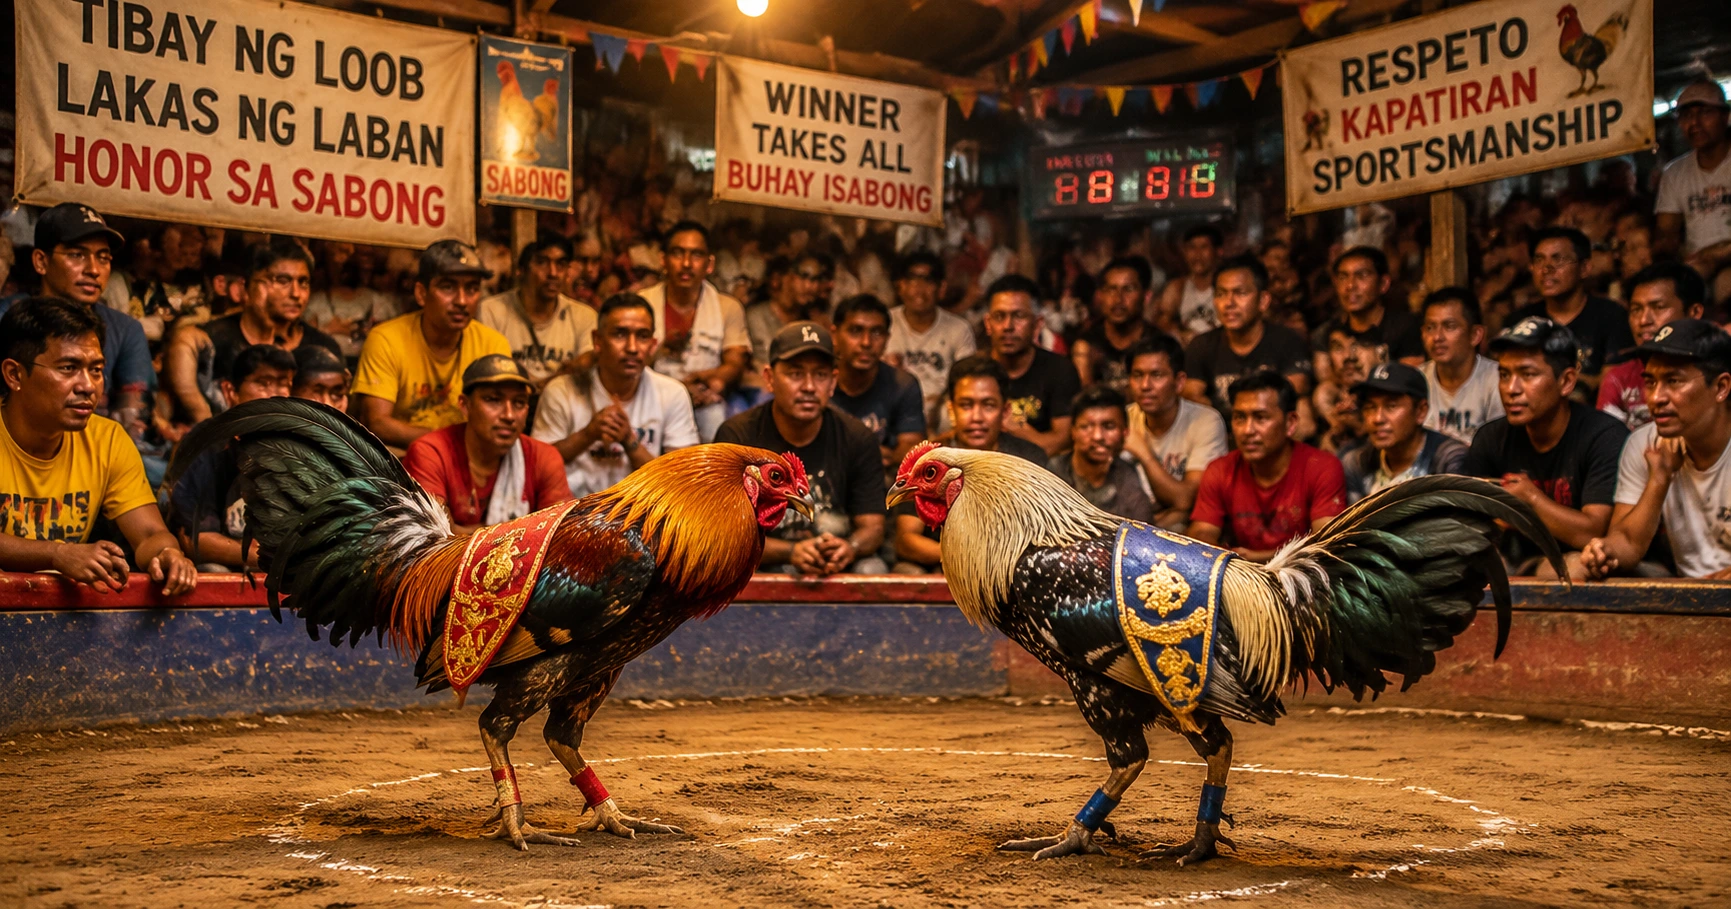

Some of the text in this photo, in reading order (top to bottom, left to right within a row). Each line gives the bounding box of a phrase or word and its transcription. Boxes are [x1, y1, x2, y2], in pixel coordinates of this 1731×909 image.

[72, 0, 425, 102] TIBAY NG LOOB
[1341, 16, 1528, 97] RESPETO
[57, 62, 444, 168] LAKAS NG LABAN
[764, 80, 901, 133] WINNER
[1341, 67, 1538, 143] KAPATIRAN
[54, 132, 446, 228] HONOR SA SABONG
[486, 163, 568, 200] SABONG
[752, 123, 912, 174] TAKES ALL
[1313, 99, 1624, 194] SPORTSMANSHIP
[727, 159, 933, 214] BUHAY ISABONG
